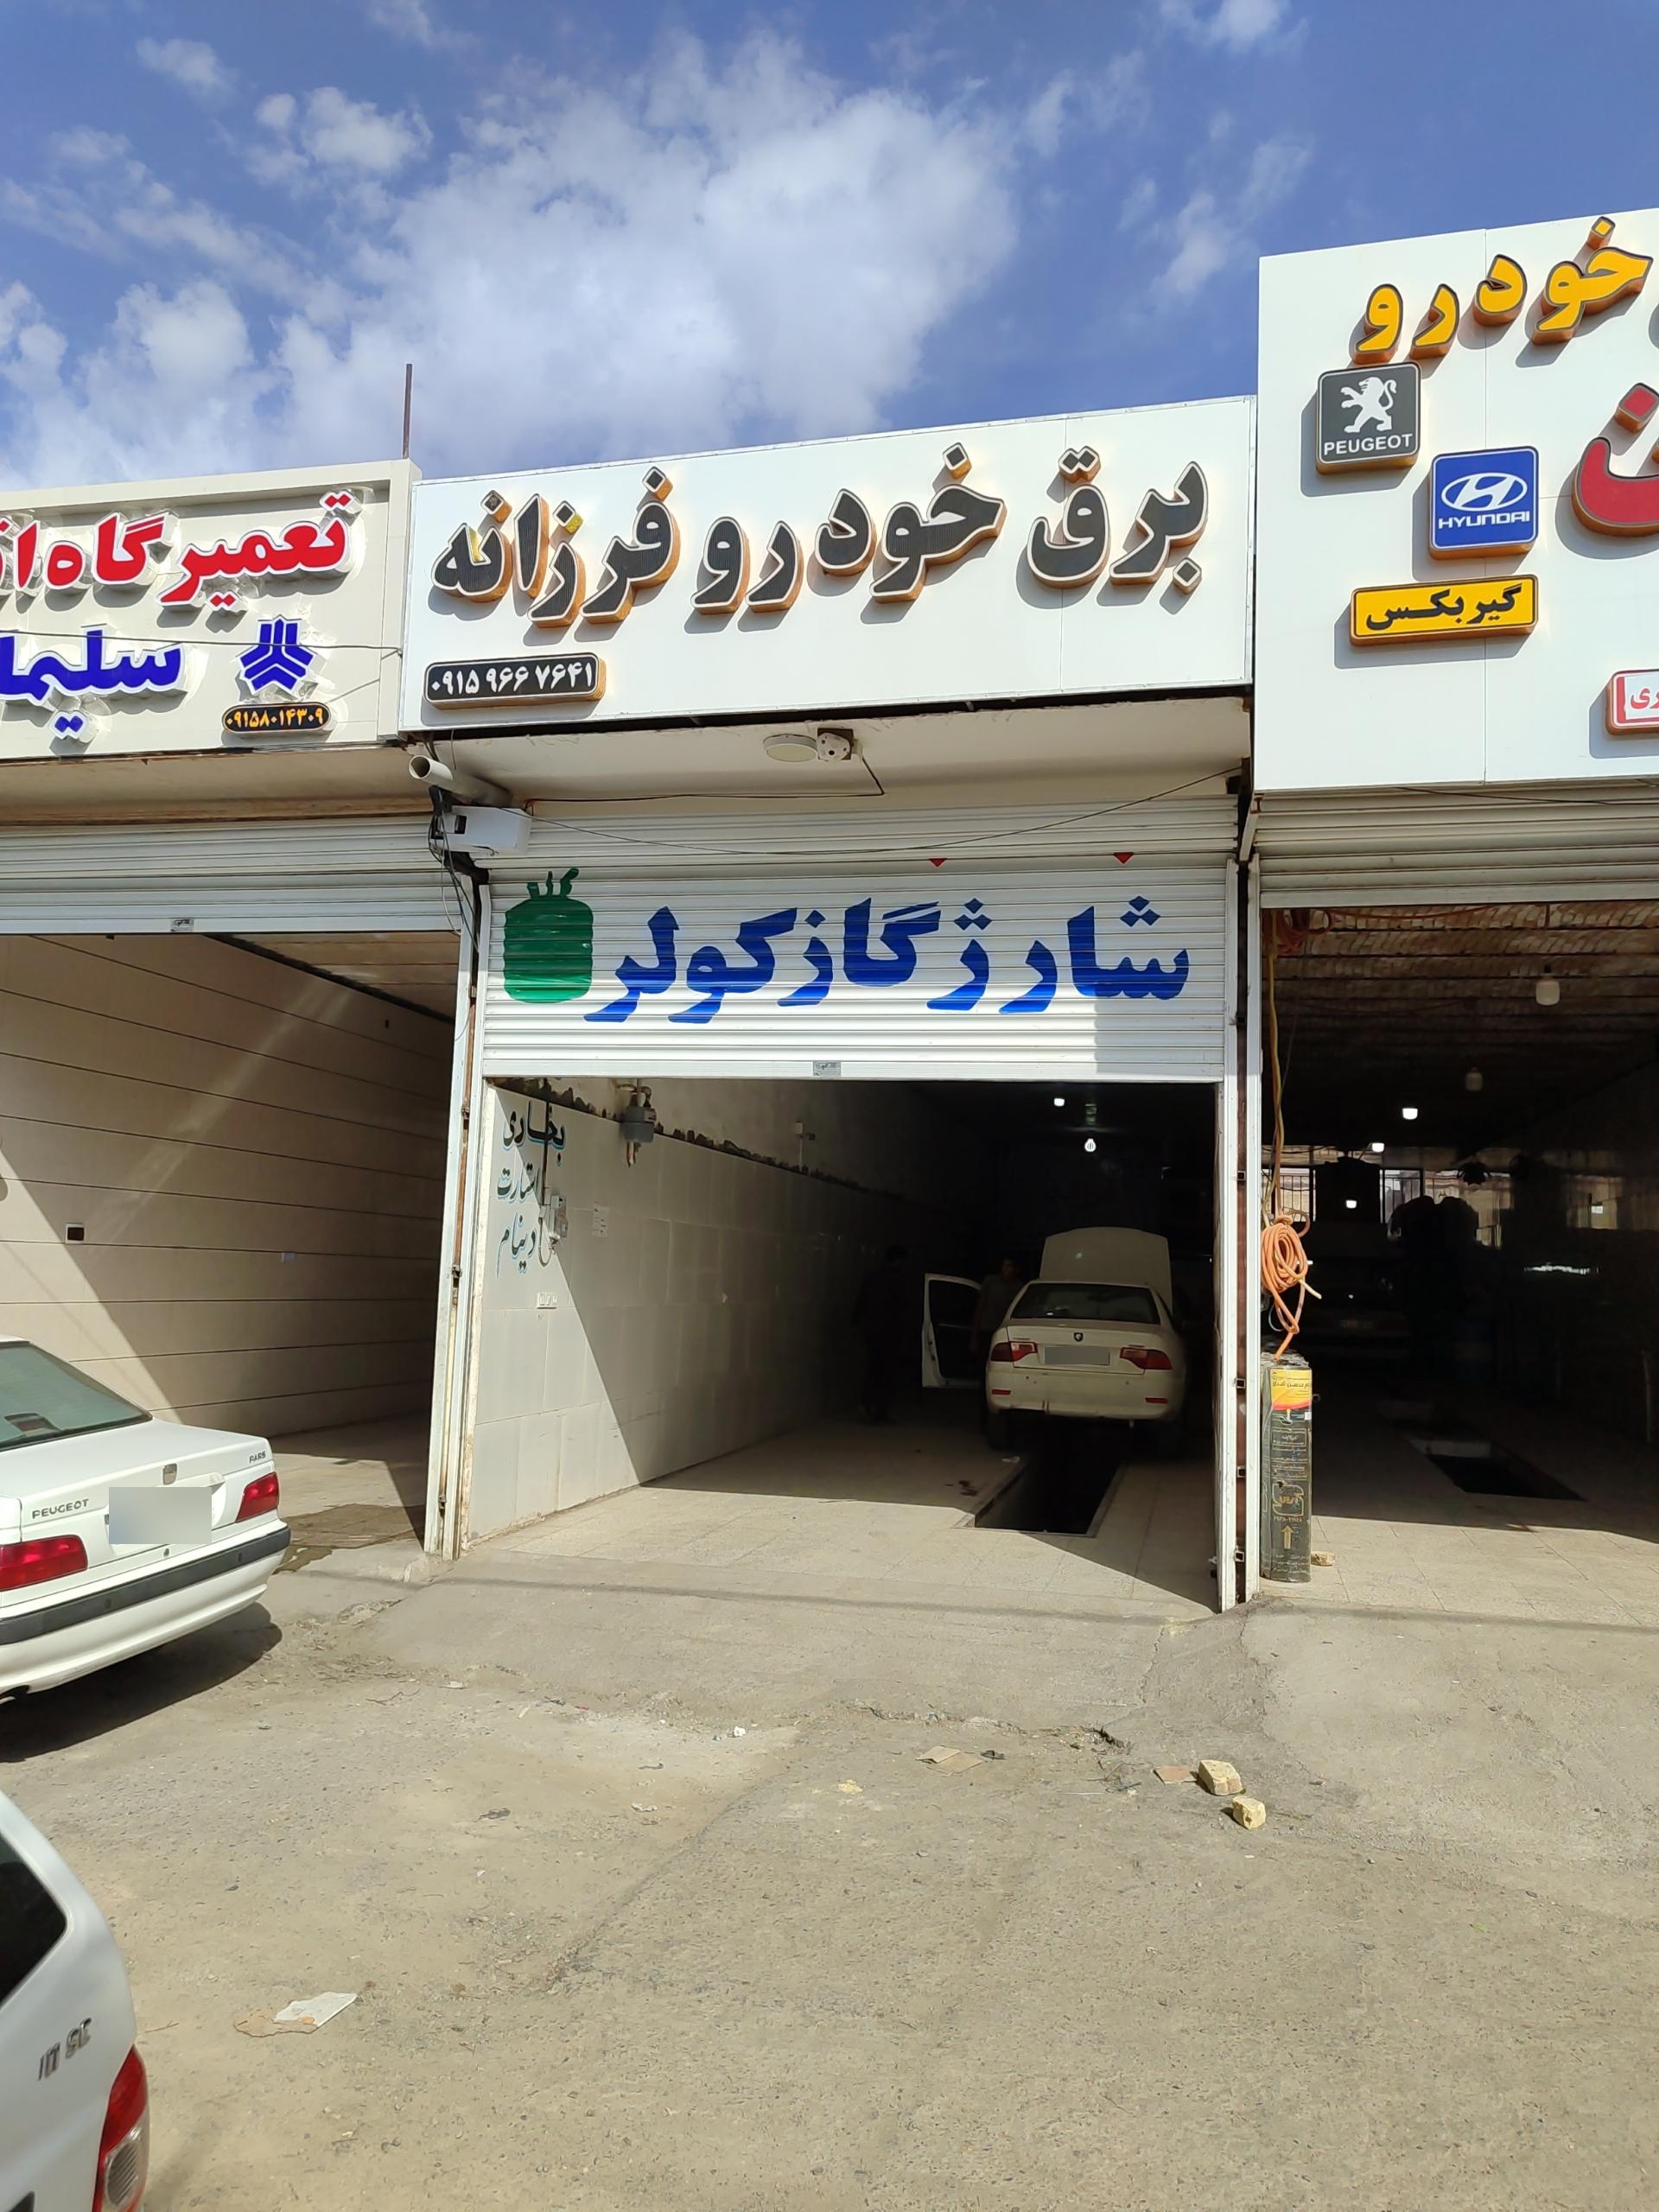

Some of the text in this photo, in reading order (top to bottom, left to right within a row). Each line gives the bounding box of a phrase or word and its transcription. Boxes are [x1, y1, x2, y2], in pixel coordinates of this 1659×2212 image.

[1356, 217, 1654, 353] خودرو
[1324, 433, 1413, 456] PEUGEOT
[432, 442, 1209, 622] برق خودرو فرزانه
[1438, 510, 1530, 530] HYUNDAI
[431, 661, 594, 696] ۰۹۱۵ ۹۶۶ ۷۶۴۱
[226, 707, 324, 728] ۰۹۱۵۸۰۱۴۳۰۹
[583, 894, 1190, 1024] شارژ گاز کولر
[502, 1100, 566, 1166] بخاری
[496, 1212, 537, 1280] دینام
[249, 1450, 267, 1465] PARS
[31, 1497, 90, 1520] PEUGEOT
